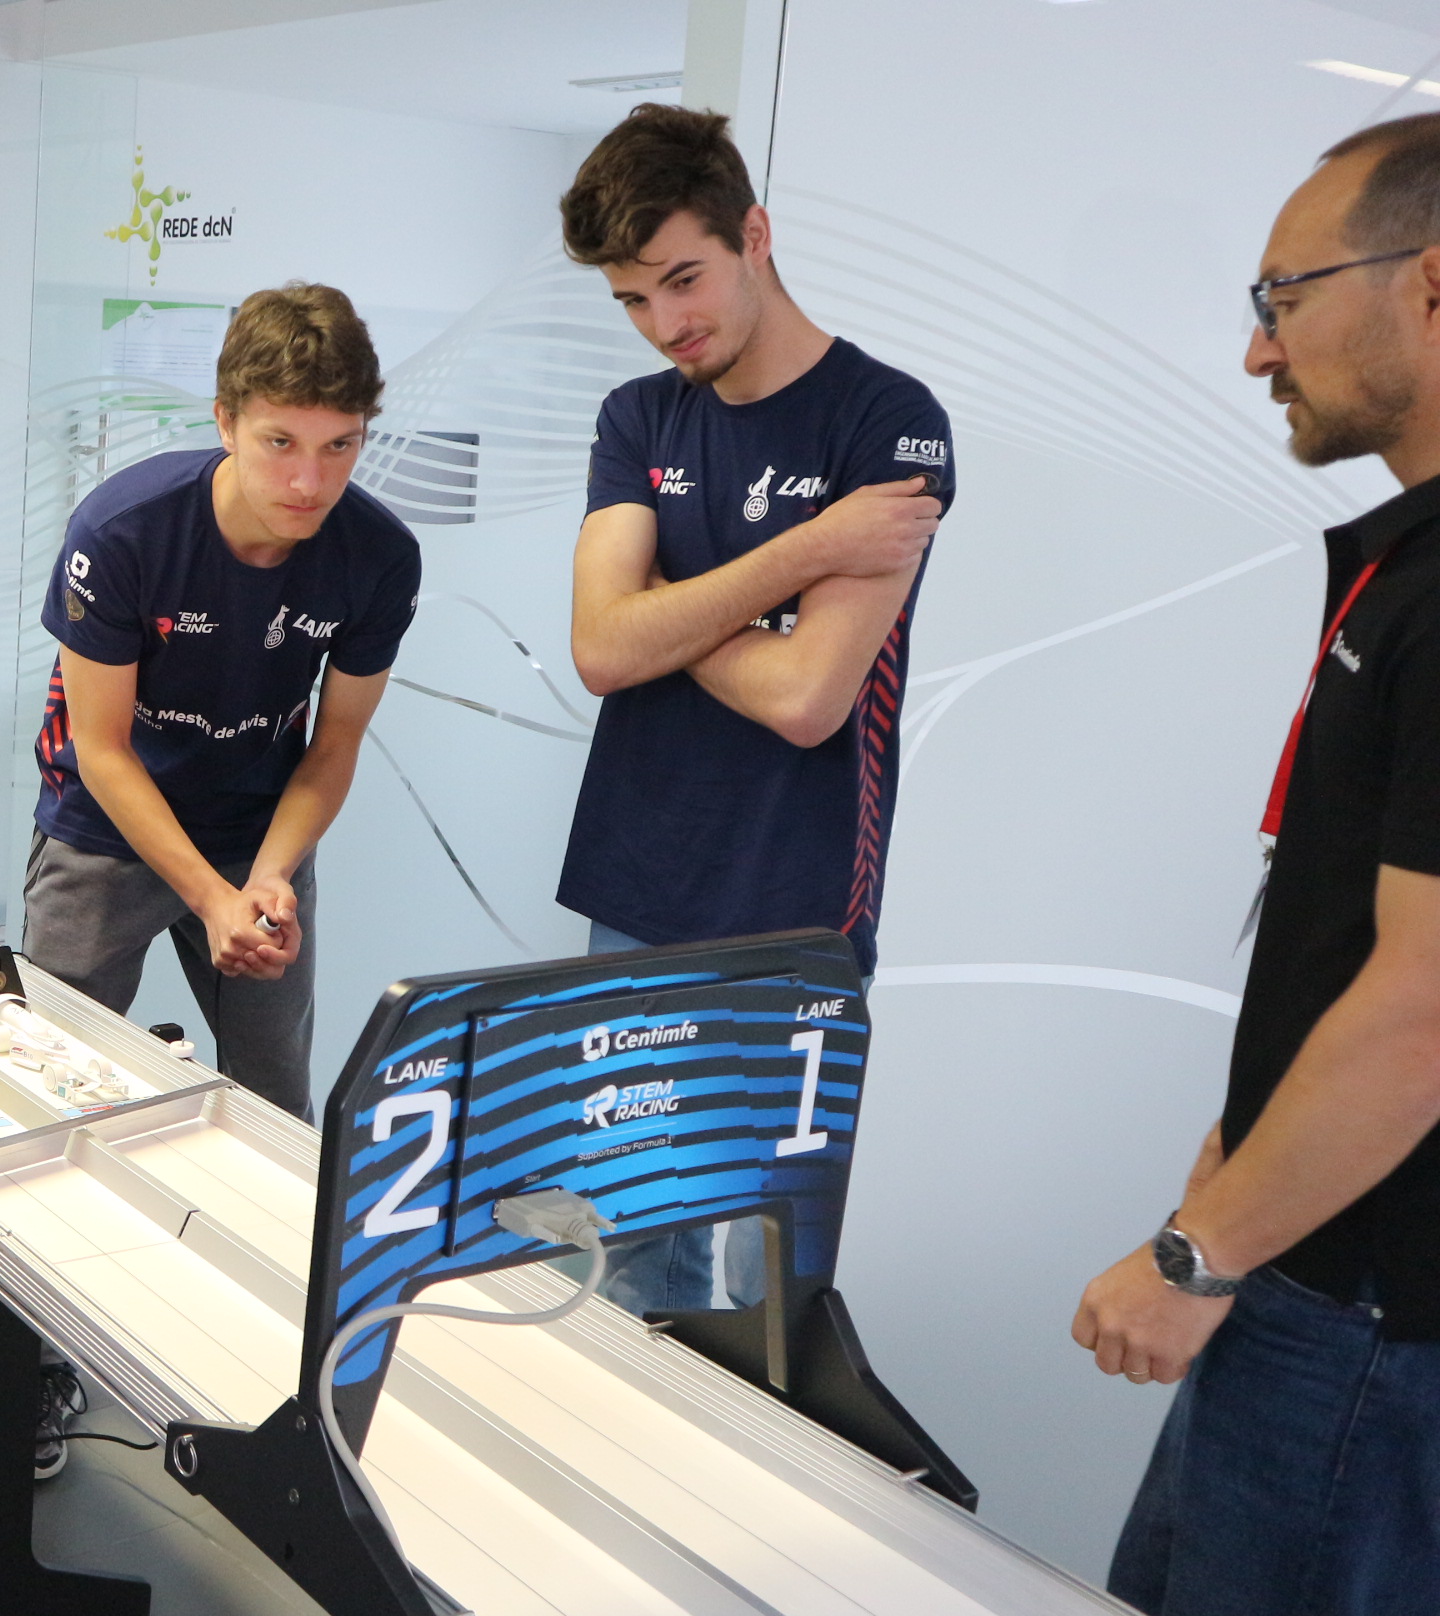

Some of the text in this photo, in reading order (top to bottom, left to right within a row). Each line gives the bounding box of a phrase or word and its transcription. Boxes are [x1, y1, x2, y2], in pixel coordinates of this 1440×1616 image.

[163, 215, 232, 238] REDE dcN
[898, 436, 946, 458] erofi
[660, 481, 692, 495] ING
[293, 614, 341, 637] LAIK
[158, 709, 212, 735] Mestre
[214, 727, 235, 739] de
[237, 714, 268, 734] Avis
[796, 999, 845, 1021] LANE
[615, 1020, 698, 1050] Centimfe
[385, 1058, 448, 1084] LANE
[620, 1079, 674, 1102] STEM
[776, 1030, 828, 1157] 1
[615, 1096, 680, 1121] RACING
[578, 1145, 620, 1161] Supported
[621, 1144, 632, 1153] by
[632, 1138, 666, 1151] Formula
[364, 1090, 451, 1238] 2
